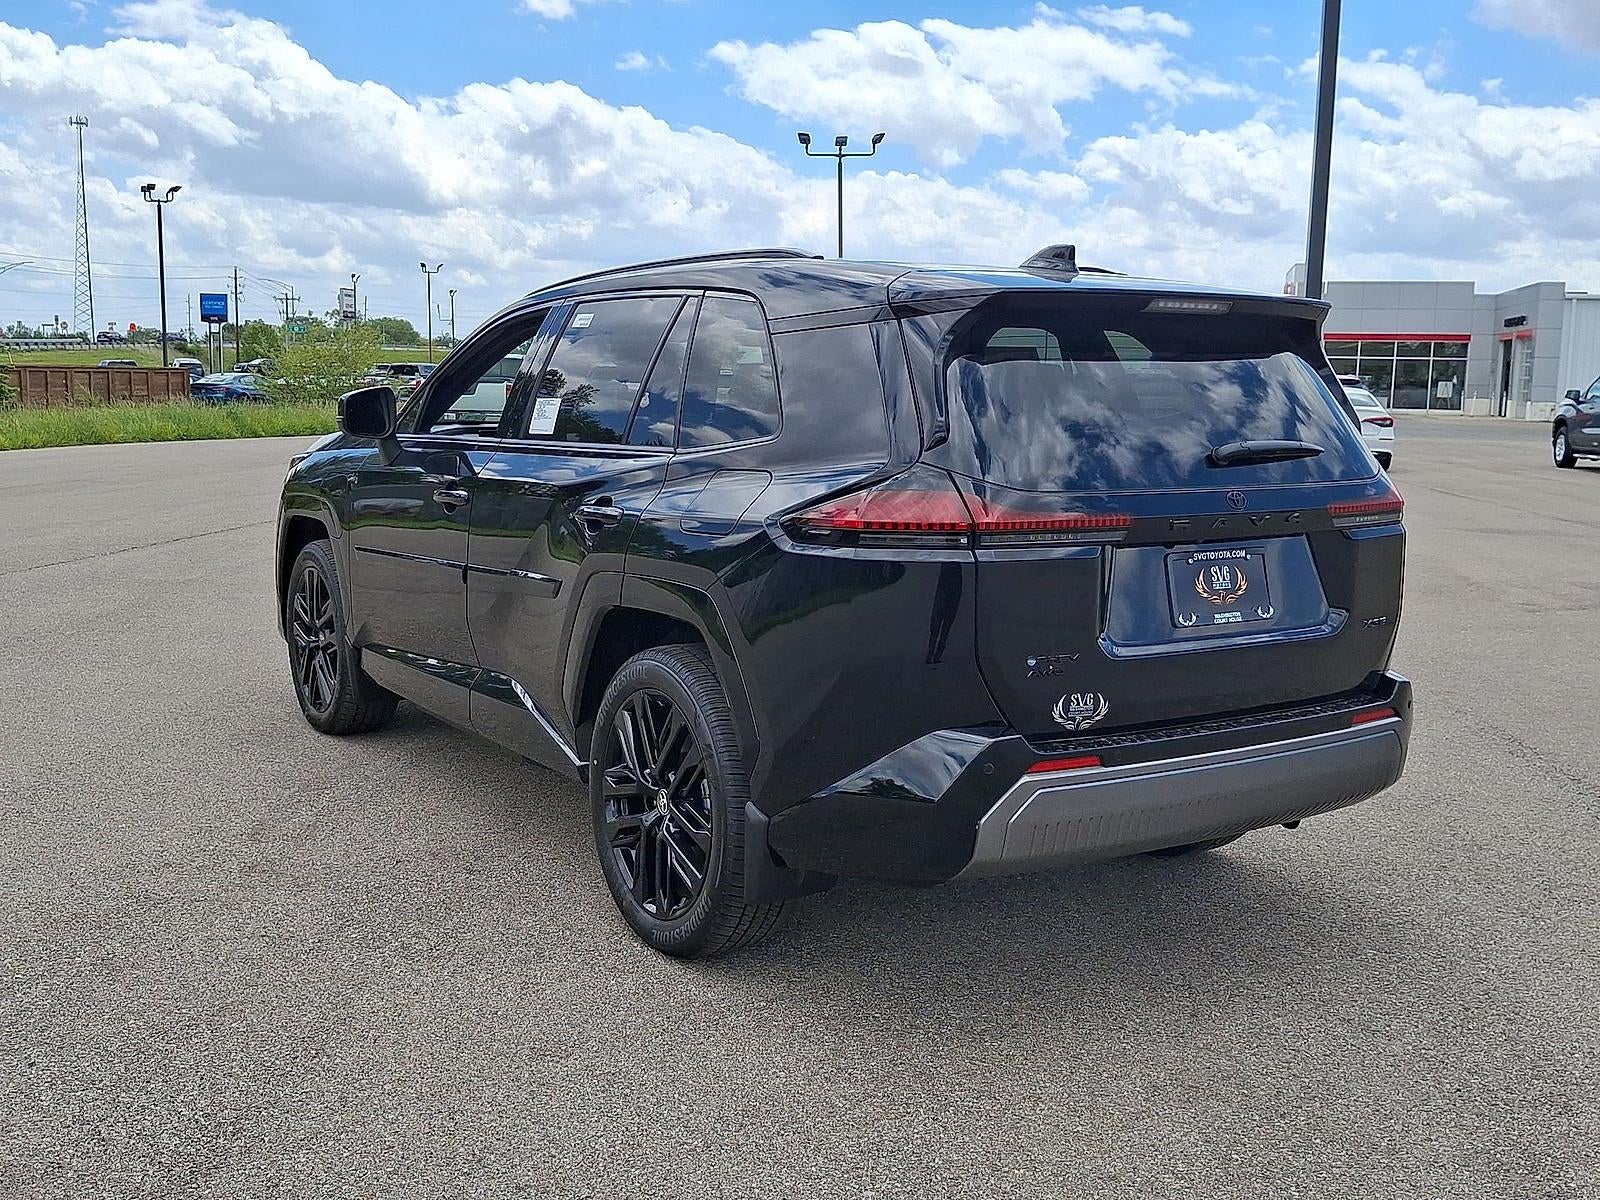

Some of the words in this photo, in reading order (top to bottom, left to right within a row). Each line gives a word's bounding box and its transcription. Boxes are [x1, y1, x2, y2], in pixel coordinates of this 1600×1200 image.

[1193, 549, 1246, 561] SVGTOYOTA.COM
[1210, 565, 1231, 582] SVG
[599, 664, 648, 728] BRIDGESTONE
[1070, 692, 1094, 707] SVG
[651, 895, 712, 948] BRIDGESTONE
